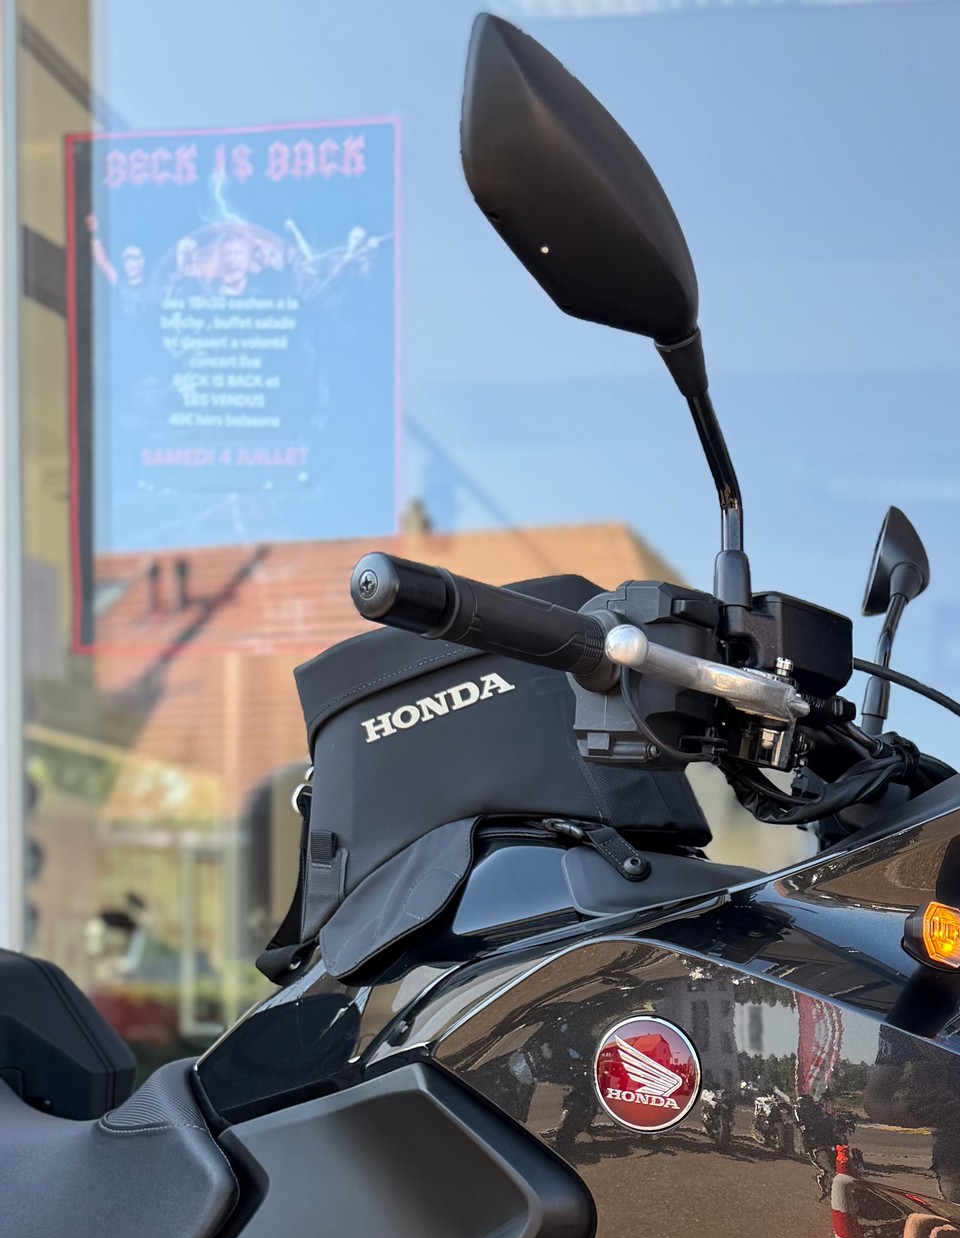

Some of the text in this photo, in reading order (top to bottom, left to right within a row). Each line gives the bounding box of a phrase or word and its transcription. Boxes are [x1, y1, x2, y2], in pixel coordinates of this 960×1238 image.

[104, 133, 367, 189] BECK IS BACK
[227, 374, 264, 388] BACK
[141, 446, 309, 467] SAMEDI 4 JUILLET
[361, 672, 515, 743] HONDA
[606, 1087, 681, 1110] HONDA
